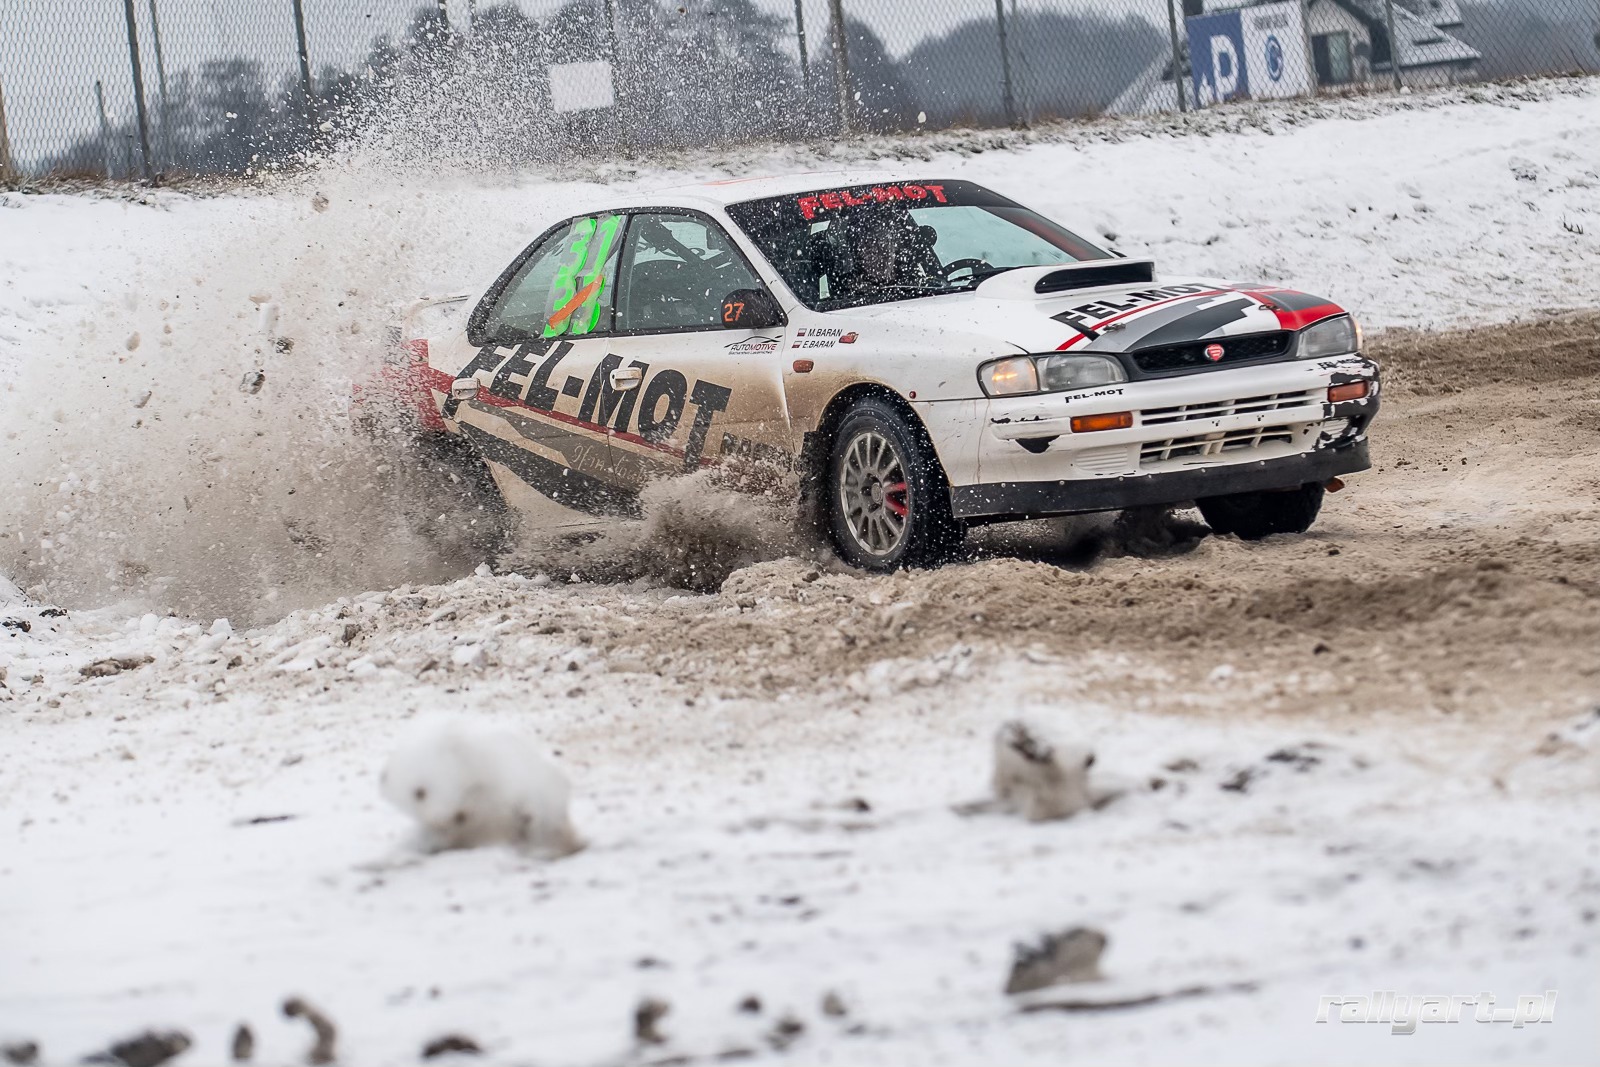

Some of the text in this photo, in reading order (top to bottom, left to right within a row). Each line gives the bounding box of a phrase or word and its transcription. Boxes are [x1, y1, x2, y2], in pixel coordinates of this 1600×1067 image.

[797, 184, 948, 220] FEL-MOT
[558, 215, 622, 277] 31
[724, 302, 745, 322] 27
[1049, 283, 1226, 341] FEL-MOT
[807, 328, 842, 337] M.BARAN
[731, 343, 778, 351] AUTOMOTIVE
[802, 341, 835, 349] E.BARAN
[442, 339, 732, 473] FEL-MOT
[1065, 388, 1124, 404] FEL-MOT
